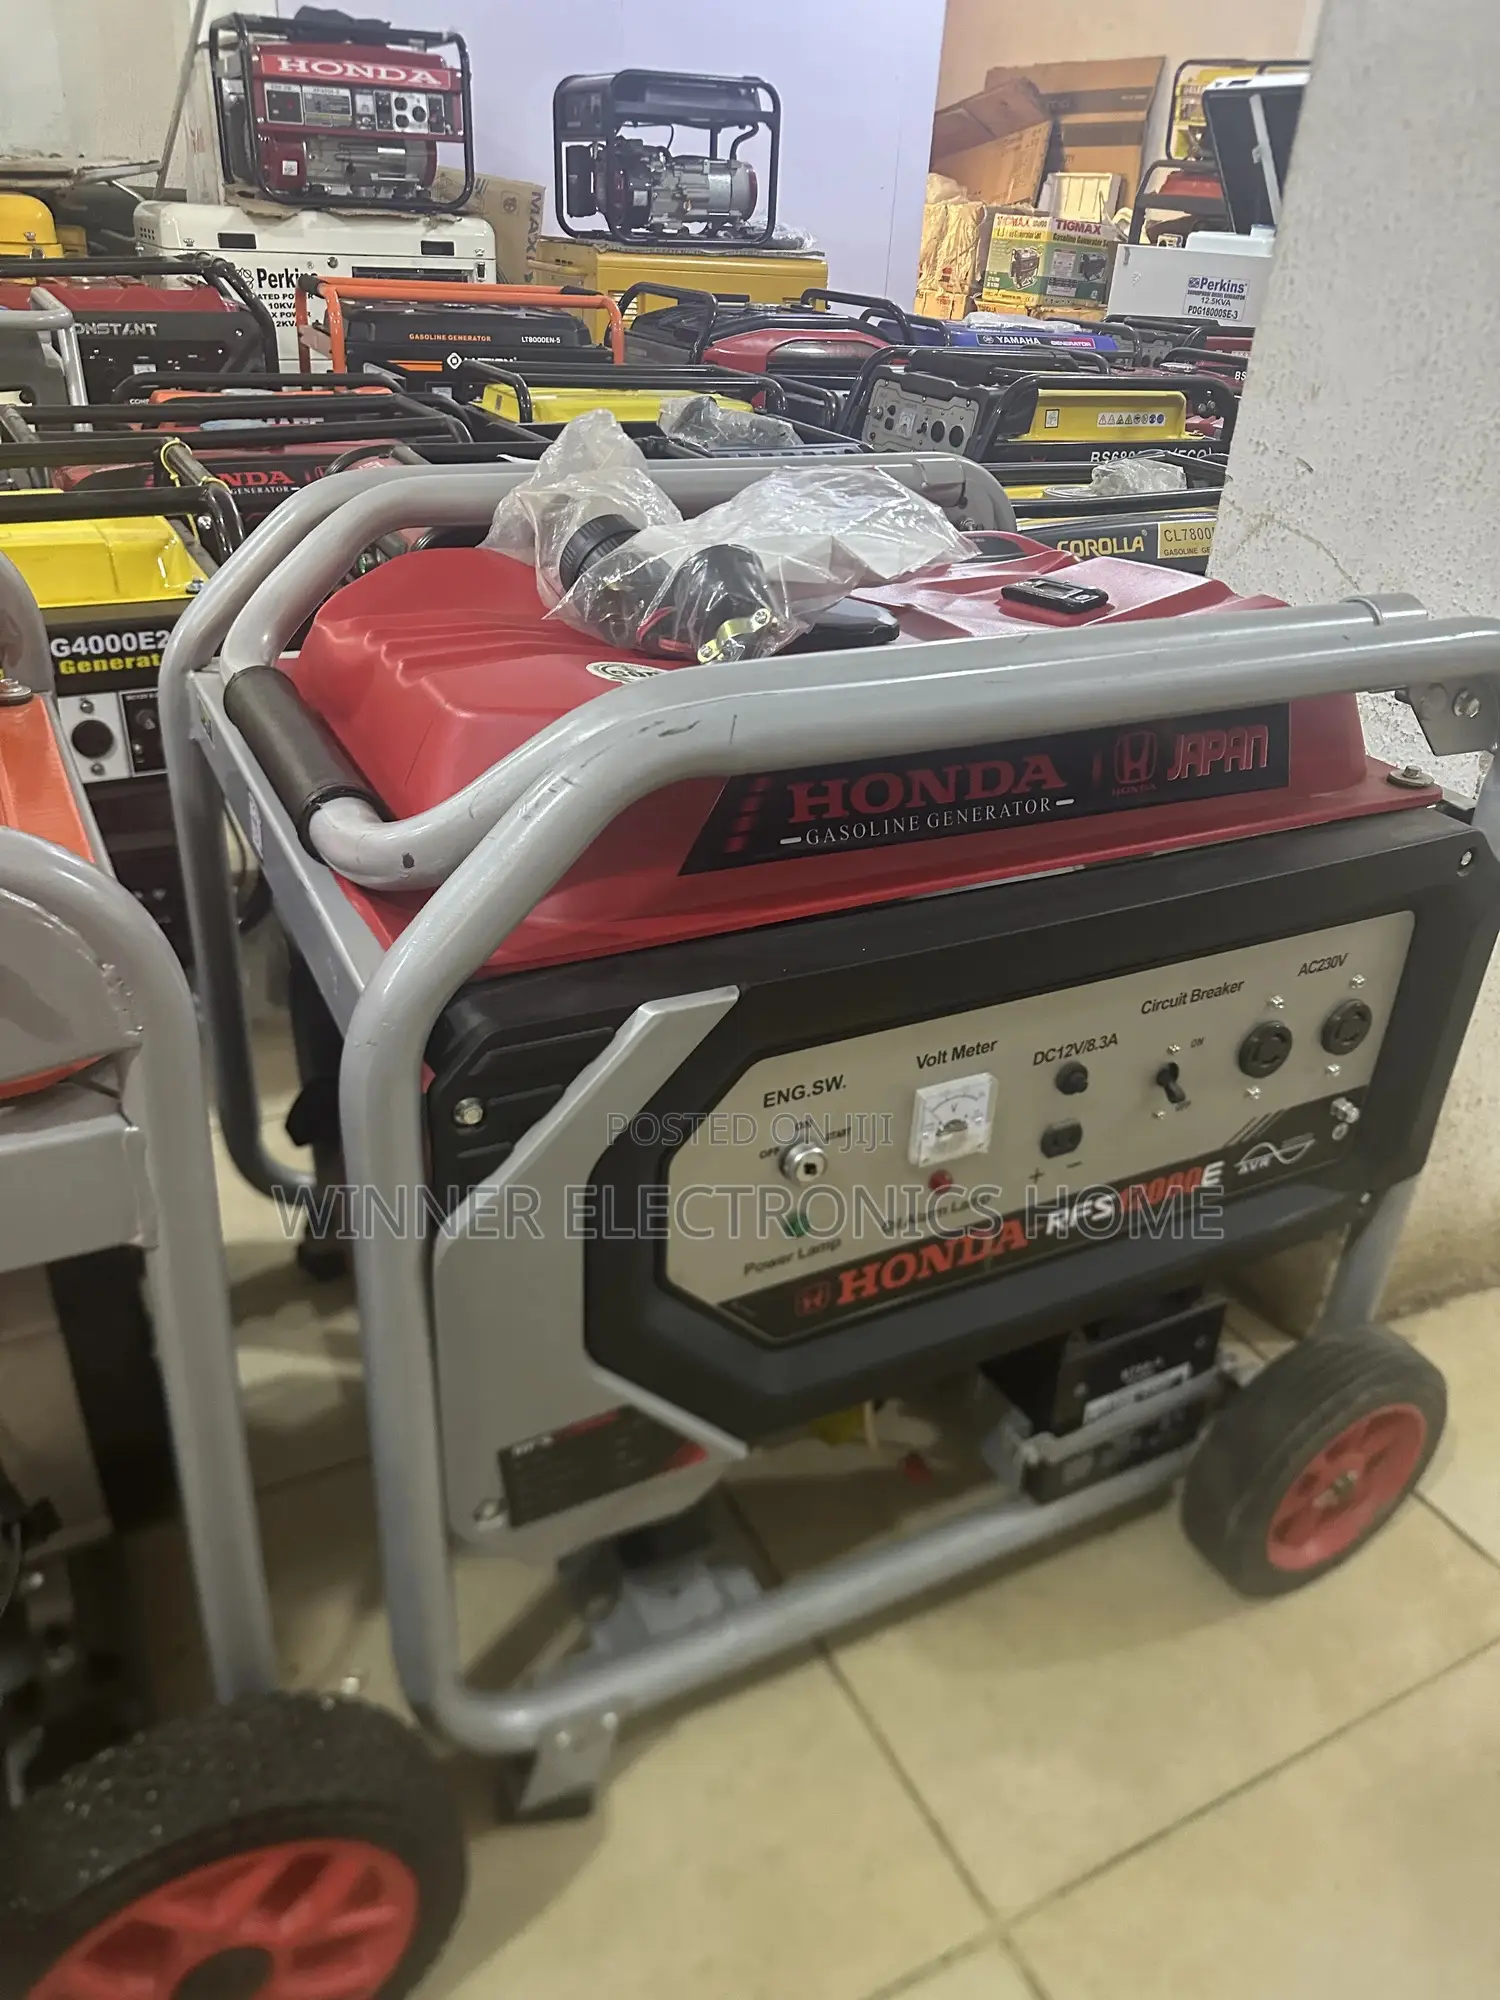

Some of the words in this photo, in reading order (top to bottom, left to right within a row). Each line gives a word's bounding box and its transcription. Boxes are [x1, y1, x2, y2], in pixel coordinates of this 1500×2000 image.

[277, 57, 442, 85] HONDA
[525, 191, 542, 260] MAX
[1055, 219, 1102, 236] TIGMAX
[256, 267, 318, 289] Perki
[1200, 277, 1245, 294] Perkins
[1187, 305, 1238, 320] PDG18000SE-3
[1201, 297, 1231, 306] 12.5KVA
[73, 322, 158, 337] ONSTANT
[409, 333, 446, 342] GASOLINE
[448, 334, 492, 342] GENERATOR
[521, 335, 561, 344] LT8000EN-5
[996, 335, 1042, 345] YAMAHA
[1050, 340, 1092, 348] GENERATOR
[216, 470, 295, 487] NDA
[231, 485, 290, 495] GENERATOR
[1056, 535, 1145, 558] COROLLA
[1163, 547, 1199, 556] GASOLINE
[59, 653, 161, 675] Generat
[1167, 724, 1269, 781] JAPAN
[788, 755, 1068, 824] HONDA
[1111, 783, 1158, 797] HONDA
[805, 814, 921, 847] GASOLINE
[926, 796, 1053, 830] GENERATOR
[1297, 952, 1349, 977] AC230V
[1140, 991, 1188, 1016] Circuit
[1189, 978, 1245, 1004] Breaker
[916, 1049, 948, 1070] Volt
[950, 1039, 999, 1062] Meter
[1032, 1032, 1119, 1066] DC12V/8.3A
[762, 1074, 848, 1108] ENG.SW.
[743, 1251, 794, 1277] Power
[797, 1238, 842, 1261] Lamp
[835, 1218, 1030, 1306] HONDA
